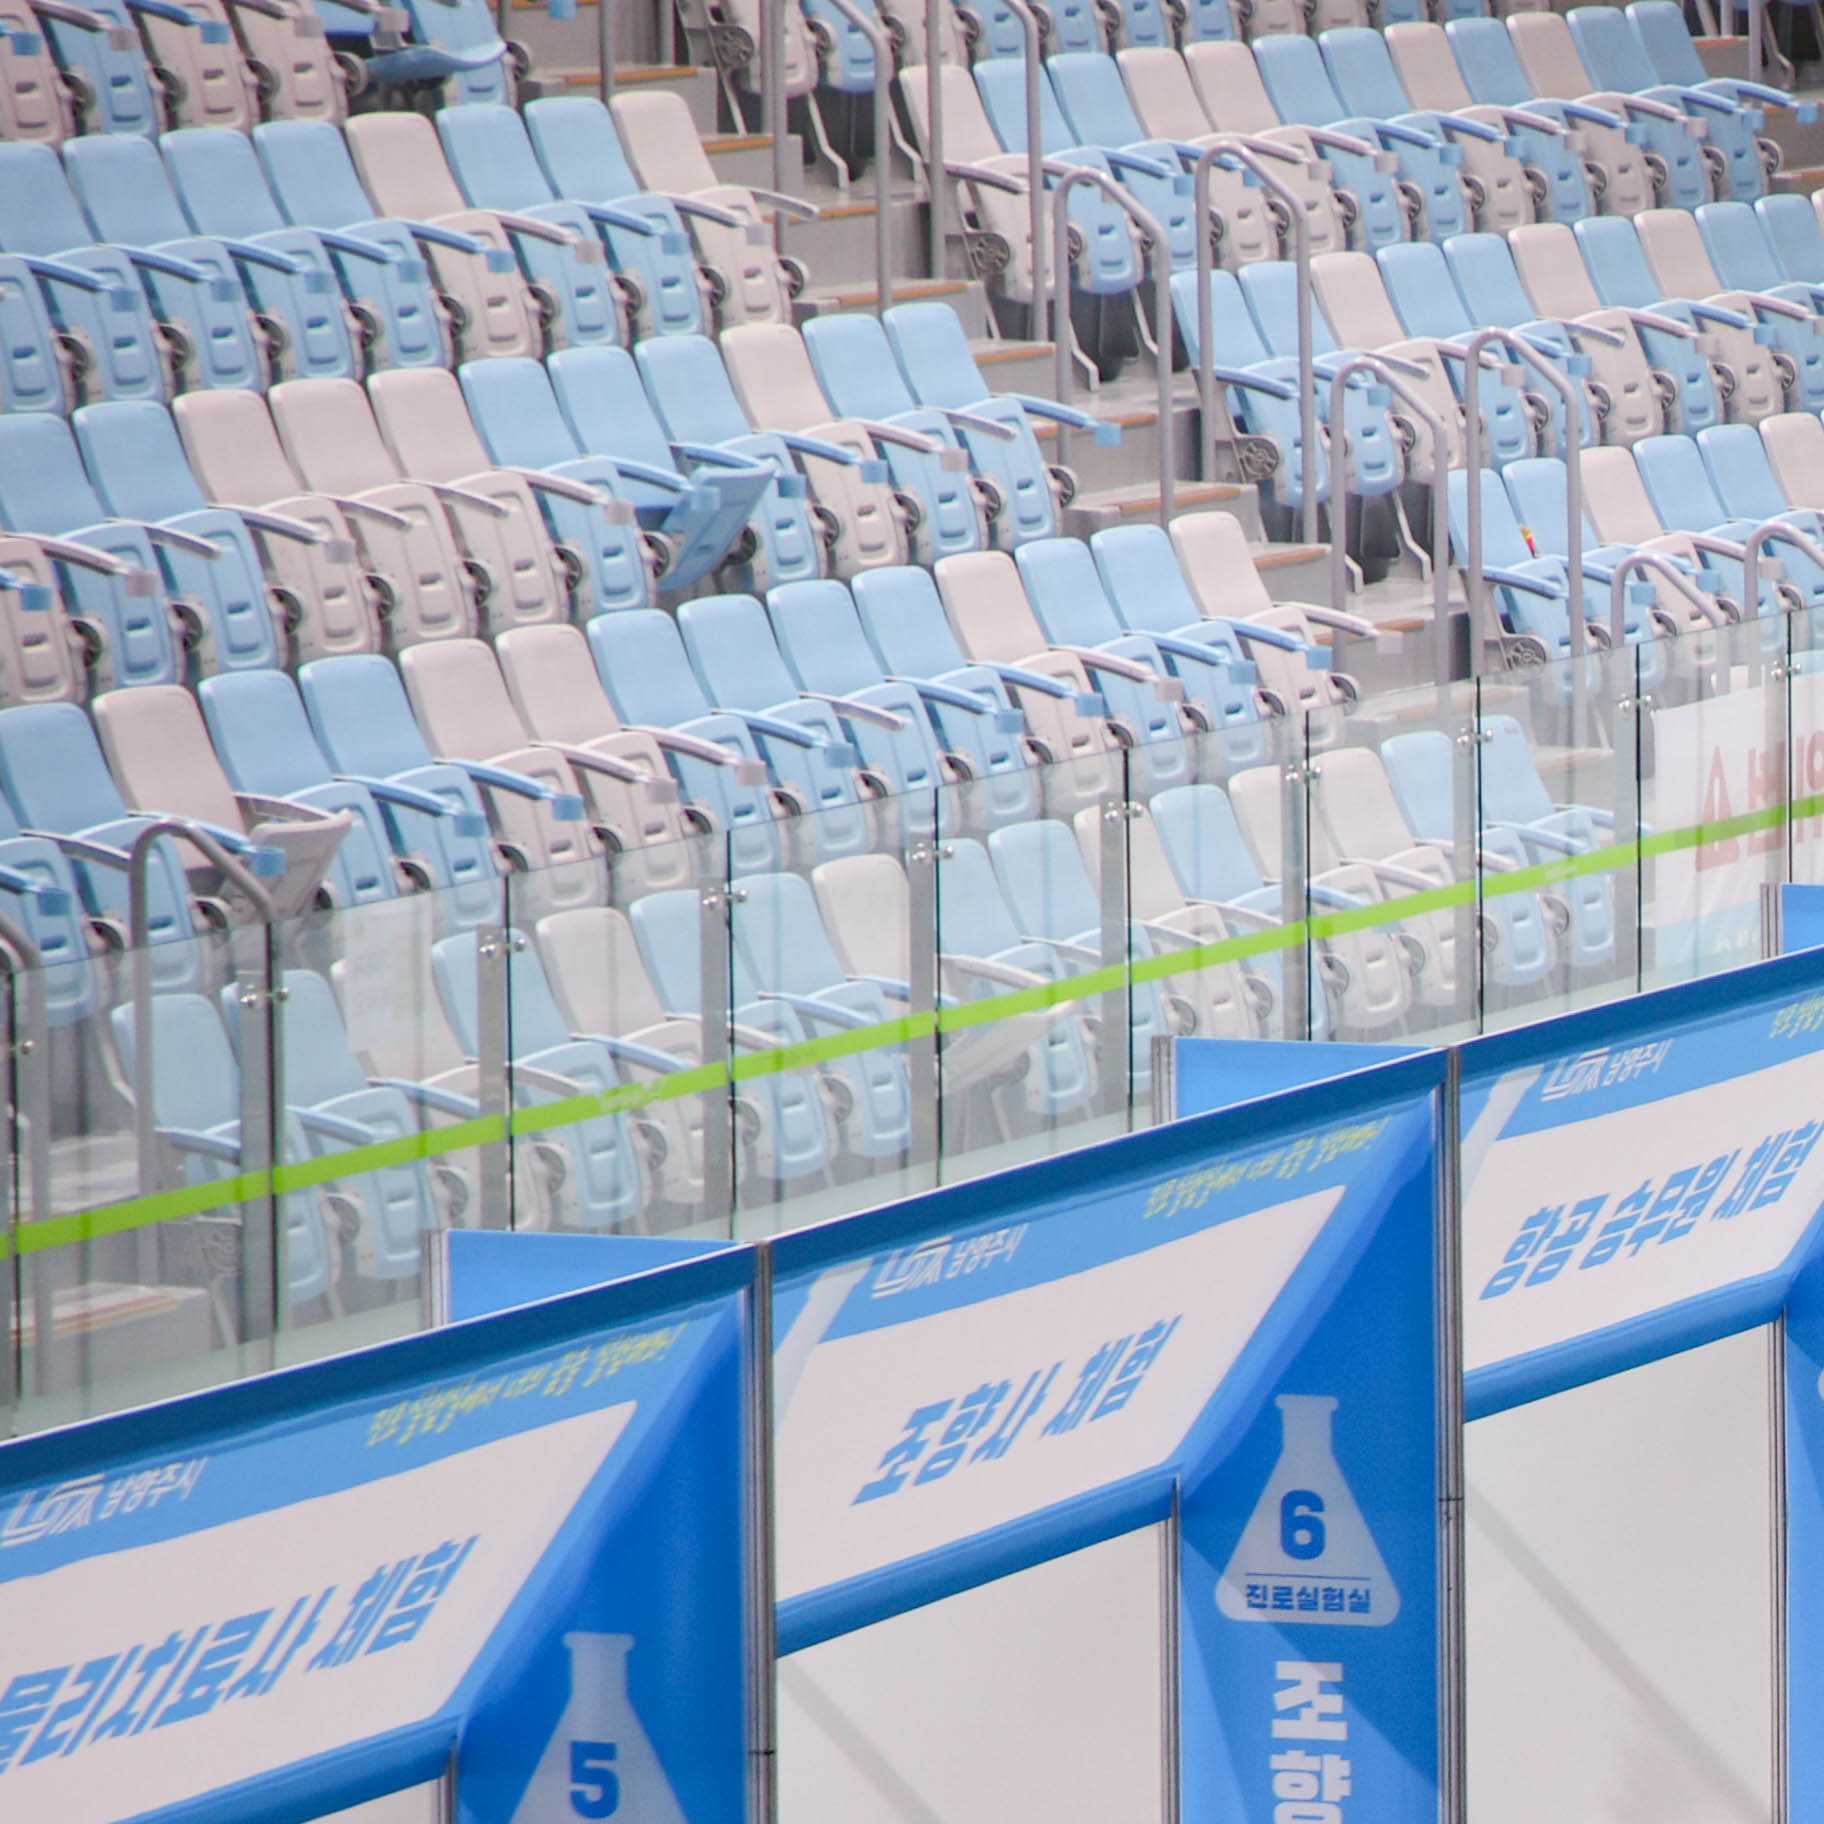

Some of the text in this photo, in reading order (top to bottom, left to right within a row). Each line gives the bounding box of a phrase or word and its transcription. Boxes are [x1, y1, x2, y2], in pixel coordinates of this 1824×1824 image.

[1602, 1037, 1675, 1086] 남양주시
[948, 1223, 1029, 1284] 남양주시
[1479, 1193, 1611, 1300] 항공
[1579, 1148, 1741, 1270] 승무원
[850, 1314, 1182, 1505] 조향사 체험
[97, 1457, 207, 1525] 남양주시
[1280, 1489, 1326, 1560] 6
[306, 1534, 480, 1673] 체험
[1244, 1585, 1371, 1614] 진로실험실
[570, 1742, 619, 1819] 5
